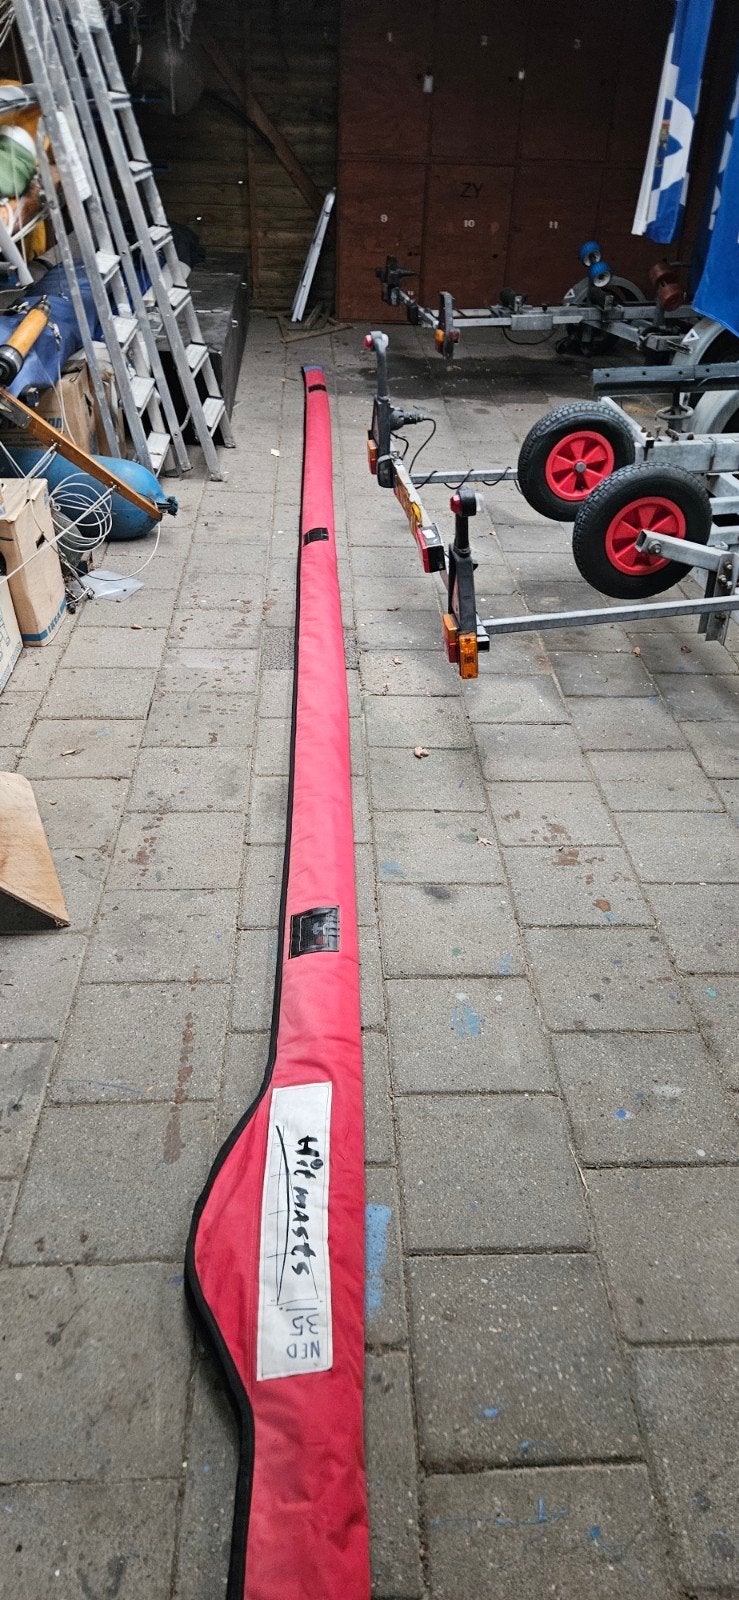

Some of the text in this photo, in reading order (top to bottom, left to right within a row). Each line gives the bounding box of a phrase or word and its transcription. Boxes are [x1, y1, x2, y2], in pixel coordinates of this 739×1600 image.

[380, 214, 388, 223] 9
[464, 219, 475, 228] 10
[549, 221, 558, 230] 11
[291, 1135, 323, 1275] Hit masts
[289, 1312, 319, 1337] 35
[286, 1339, 321, 1360] NED
